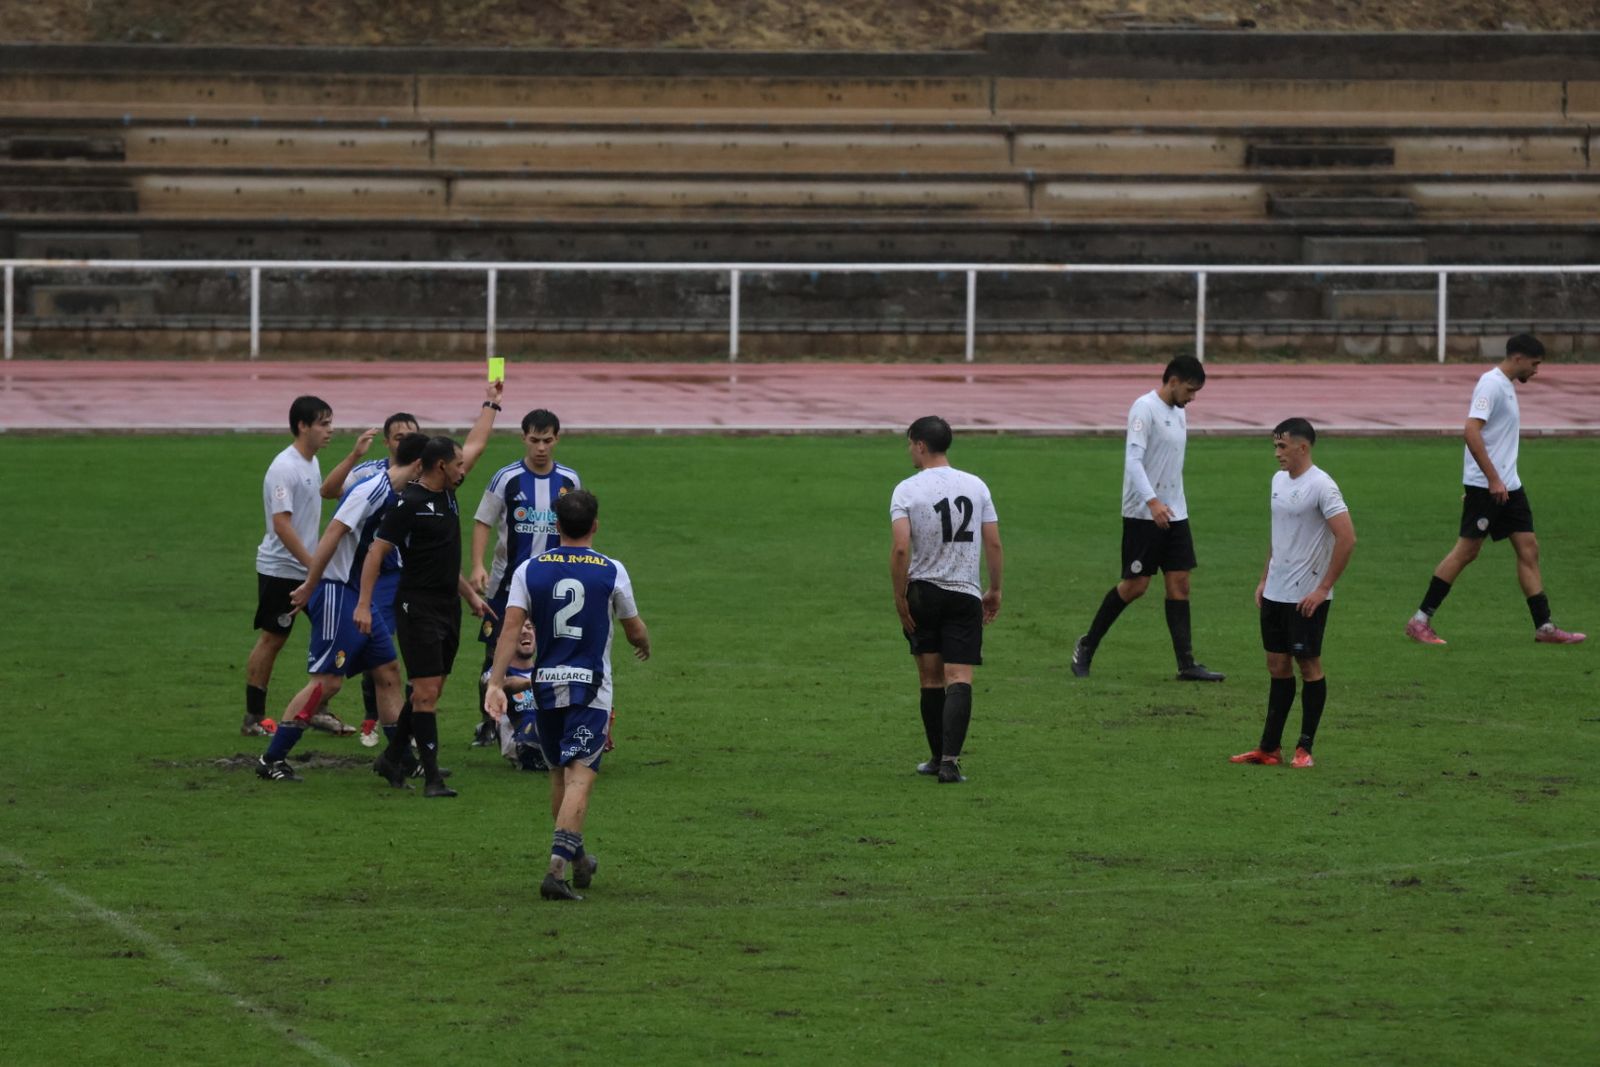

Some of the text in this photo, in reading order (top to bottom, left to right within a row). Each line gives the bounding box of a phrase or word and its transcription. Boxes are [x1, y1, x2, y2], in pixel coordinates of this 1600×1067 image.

[933, 495, 974, 543] 12
[515, 523, 559, 534] CRICURS
[538, 554, 564, 563] CAJA
[552, 578, 585, 640] 2
[545, 671, 591, 682] VALCARCE
